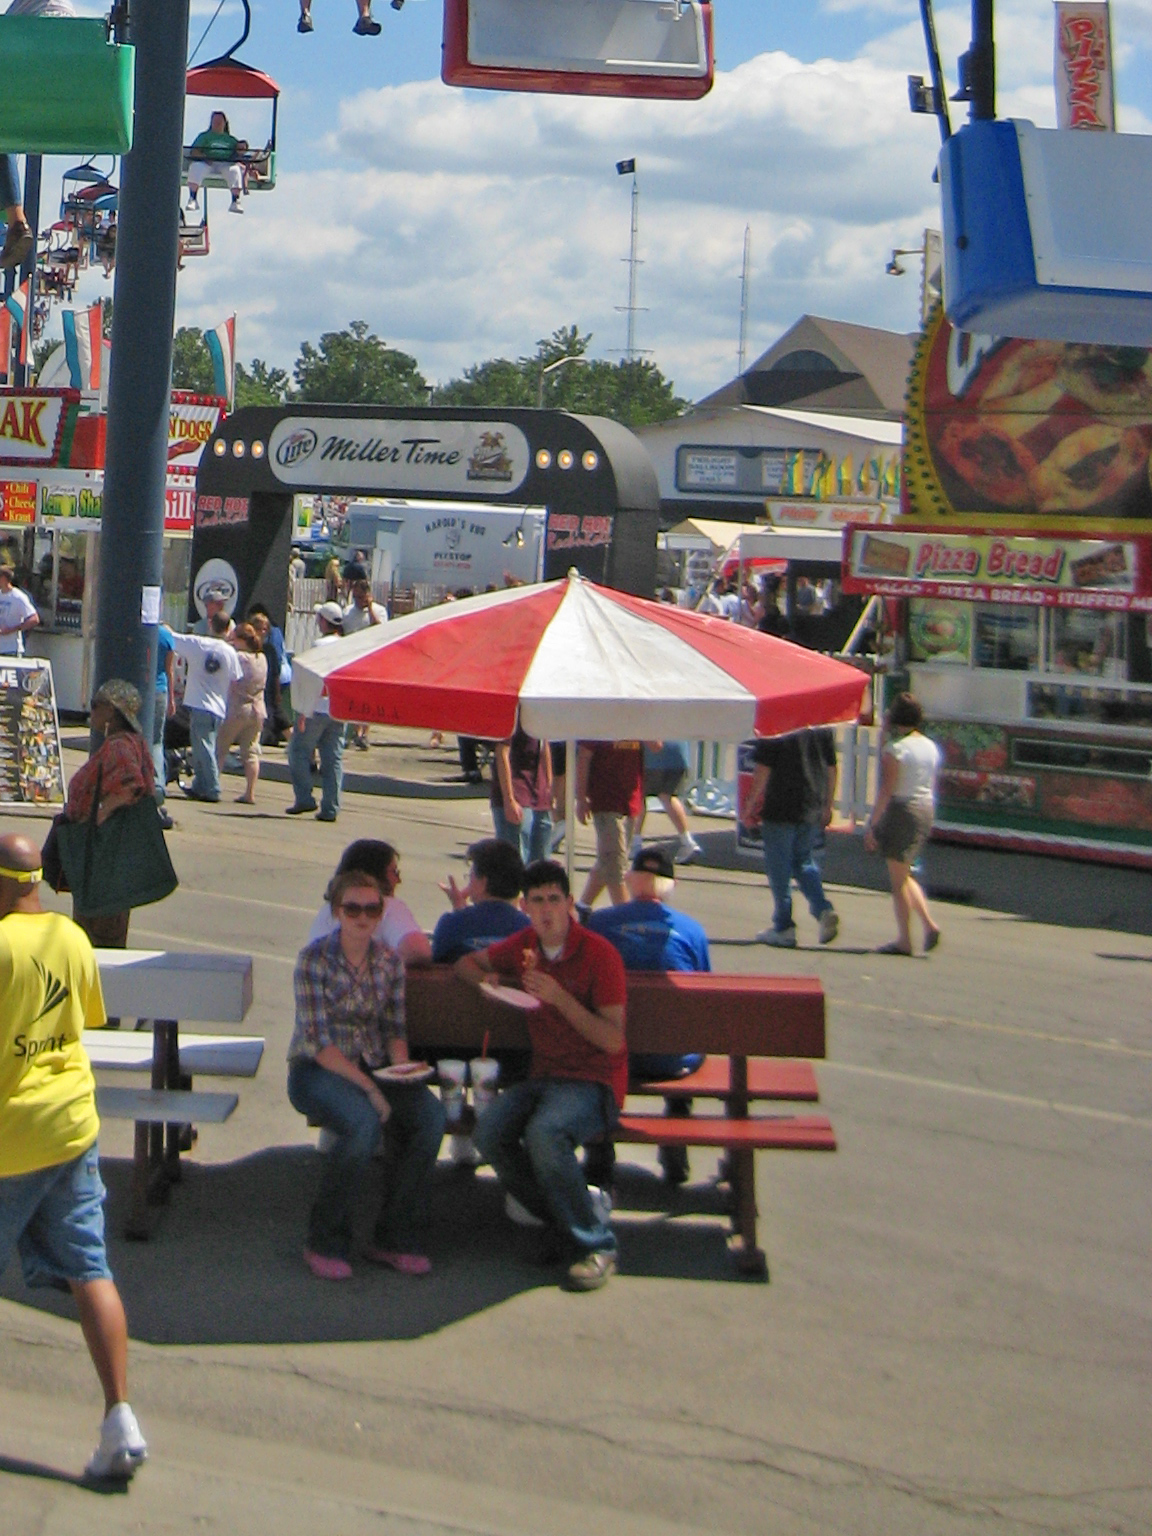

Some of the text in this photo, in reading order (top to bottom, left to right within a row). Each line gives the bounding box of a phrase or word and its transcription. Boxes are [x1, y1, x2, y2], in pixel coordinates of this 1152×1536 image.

[1065, 17, 1107, 128] PIZZA
[179, 419, 212, 441] DOGS
[320, 436, 402, 464] Miller
[400, 438, 461, 465] Time
[9, 482, 30, 494] Chili
[8, 496, 36, 510] Cheese
[8, 510, 32, 523] Kraut
[914, 541, 1066, 582] Pizza Bread
[938, 585, 987, 600] PIZZA
[990, 588, 1043, 604] BREAD
[1057, 591, 1127, 608] STUFFED
